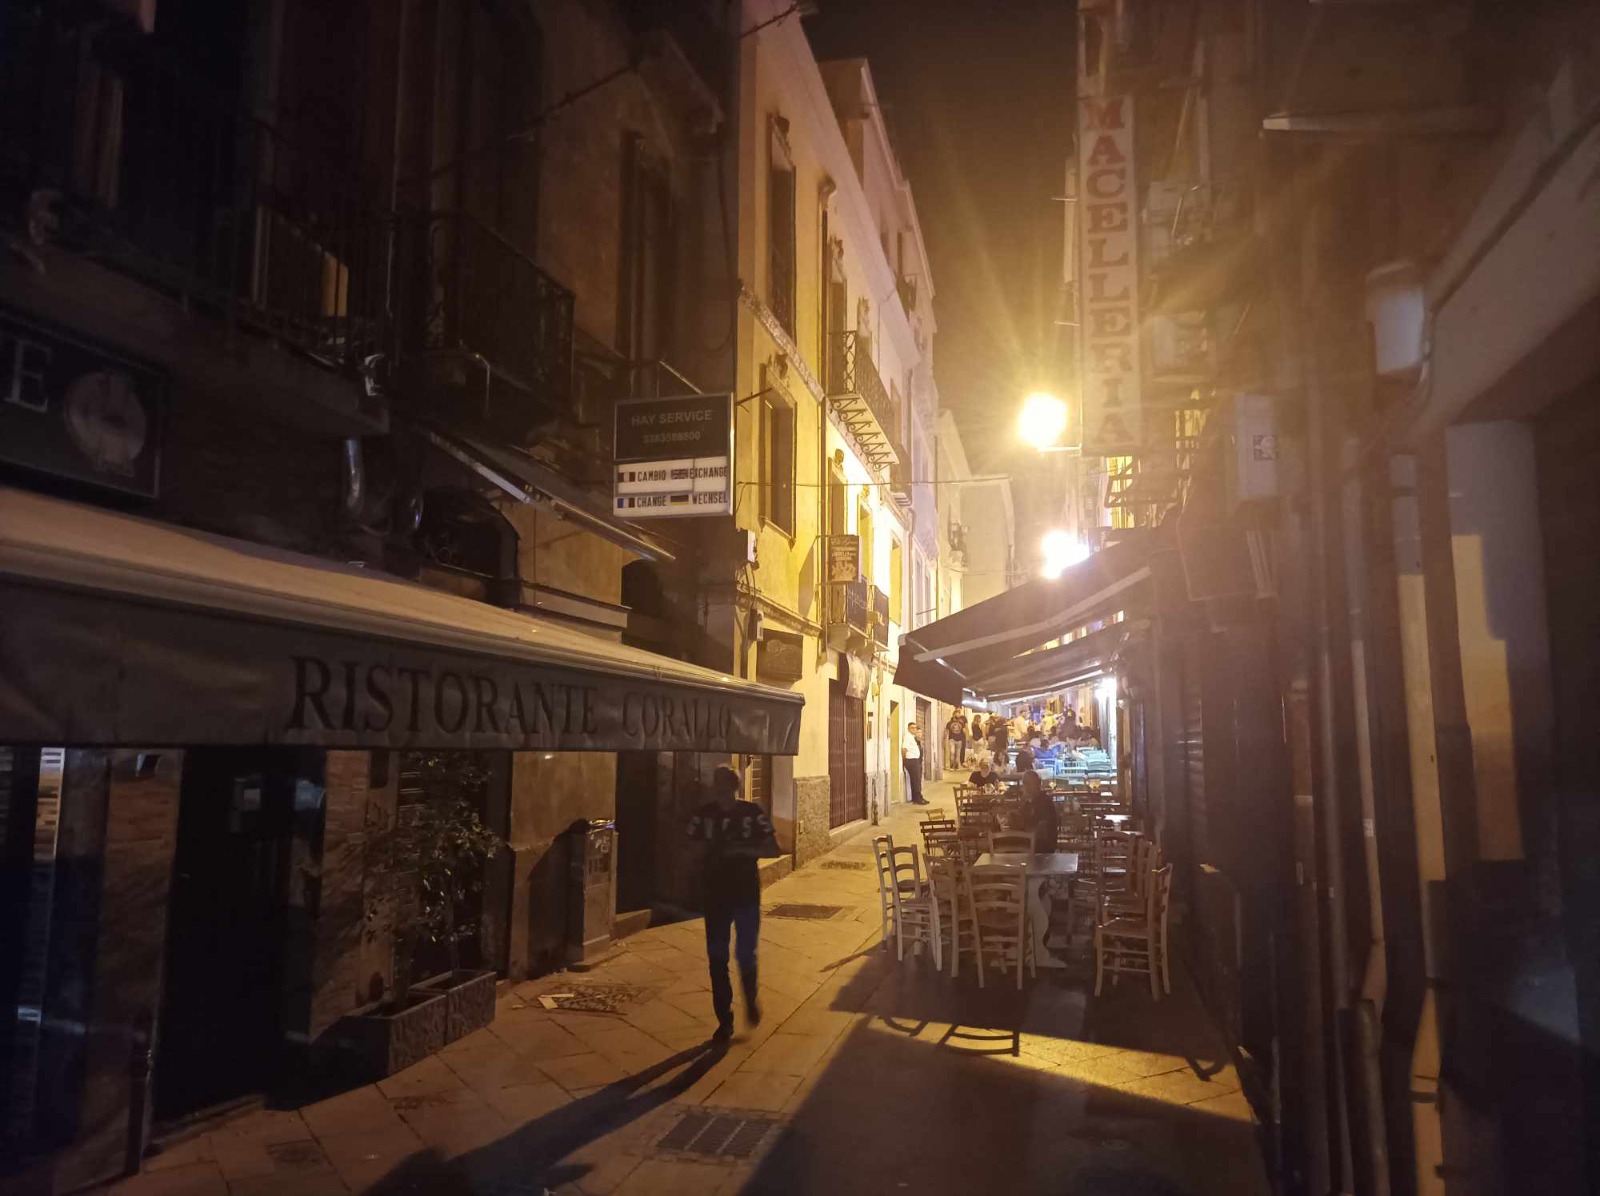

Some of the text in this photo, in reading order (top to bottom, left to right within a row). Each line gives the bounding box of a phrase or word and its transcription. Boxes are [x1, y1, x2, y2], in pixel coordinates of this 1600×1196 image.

[1084, 100, 1133, 443] MACELLERIA
[631, 409, 712, 428] HAY SERVICE
[637, 466, 728, 482] CAMBIO EXCHANGE
[637, 495, 667, 508] CHANGE
[286, 655, 732, 740] RISTORANTE CORALLO
